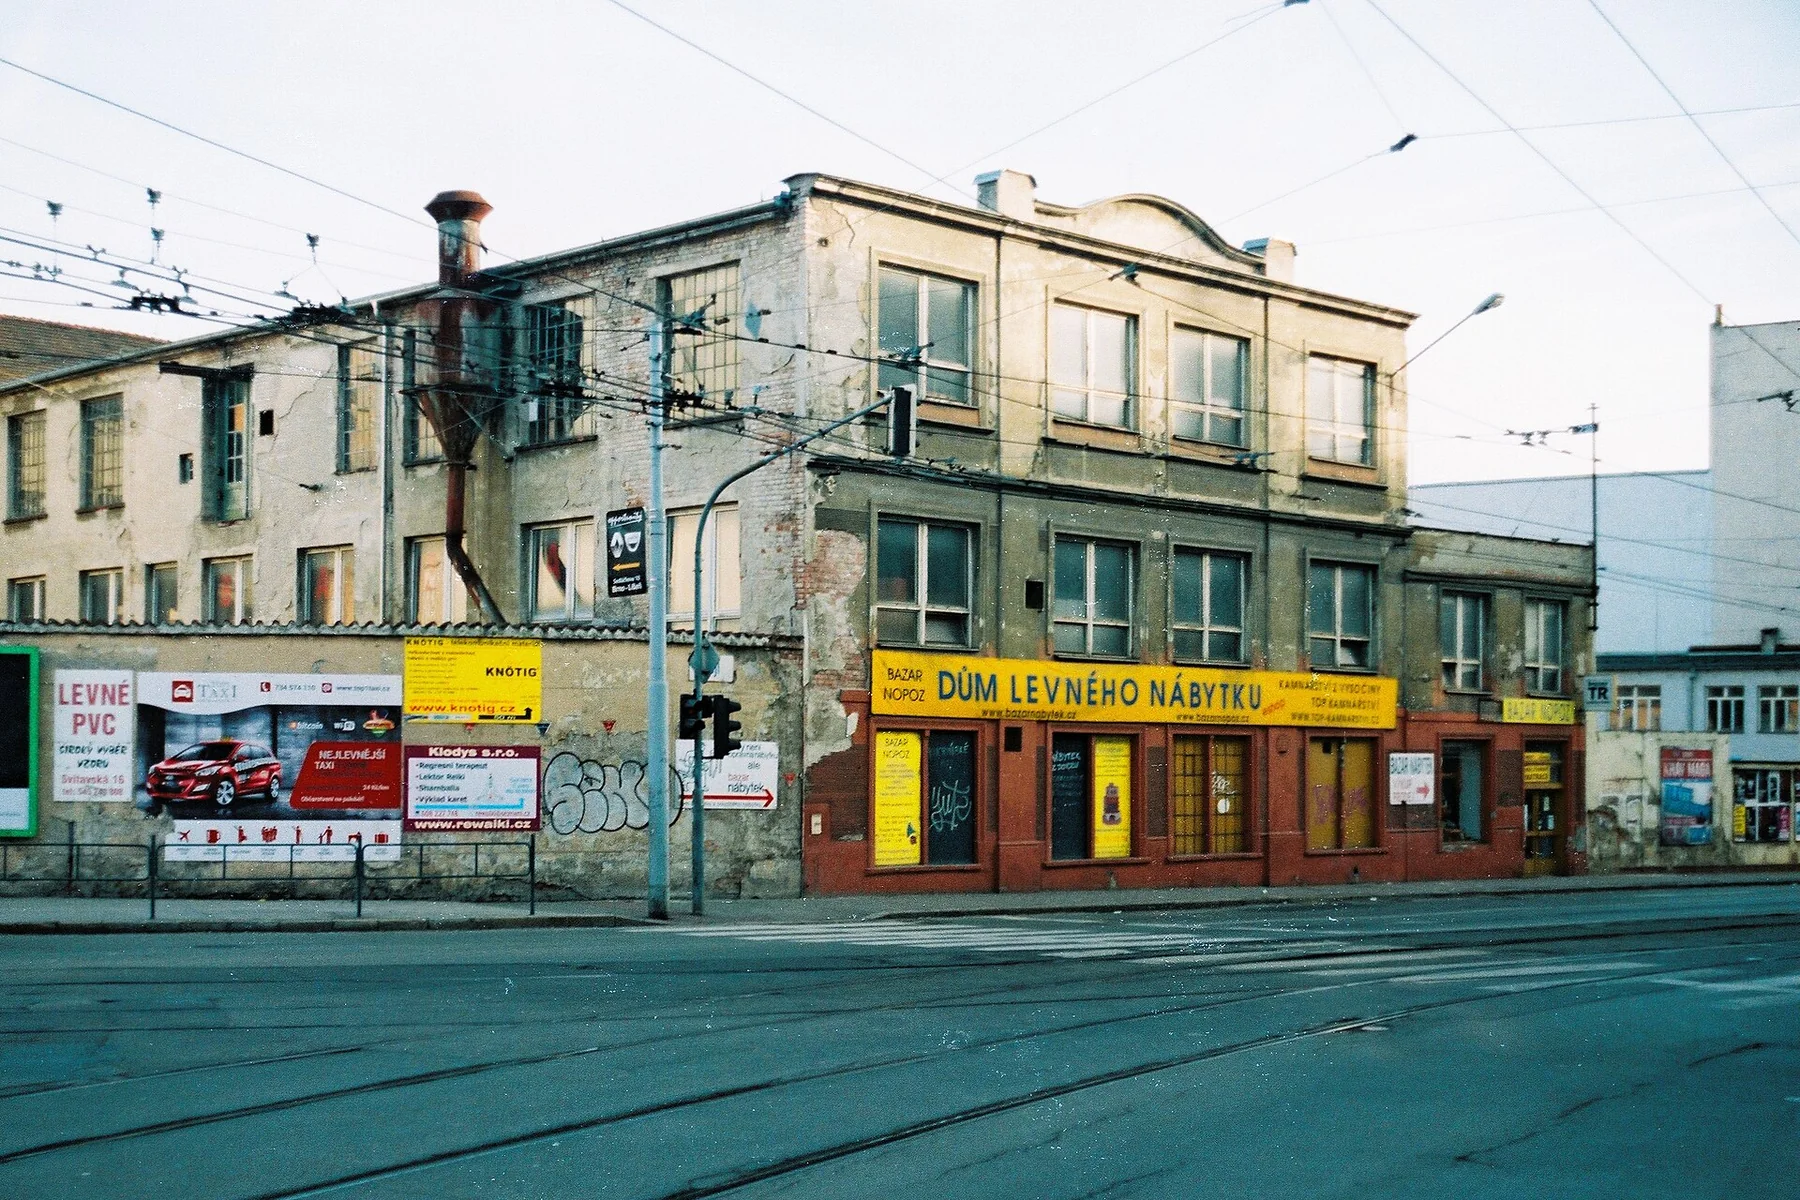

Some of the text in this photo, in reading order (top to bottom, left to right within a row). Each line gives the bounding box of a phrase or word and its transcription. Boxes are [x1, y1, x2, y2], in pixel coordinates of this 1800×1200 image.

[887, 667, 923, 682] BAZAR
[58, 679, 130, 706] LEVNÉ
[938, 665, 997, 703] DŮM
[1011, 669, 1139, 706] LEVNÉHO
[1150, 673, 1262, 710] NÁBYTKU
[1587, 687, 1608, 700] TR
[883, 688, 925, 702] NOPOZ
[72, 713, 116, 735] PVC
[428, 747, 520, 759] Klodys s.r.o.
[314, 761, 335, 770] TAXI
